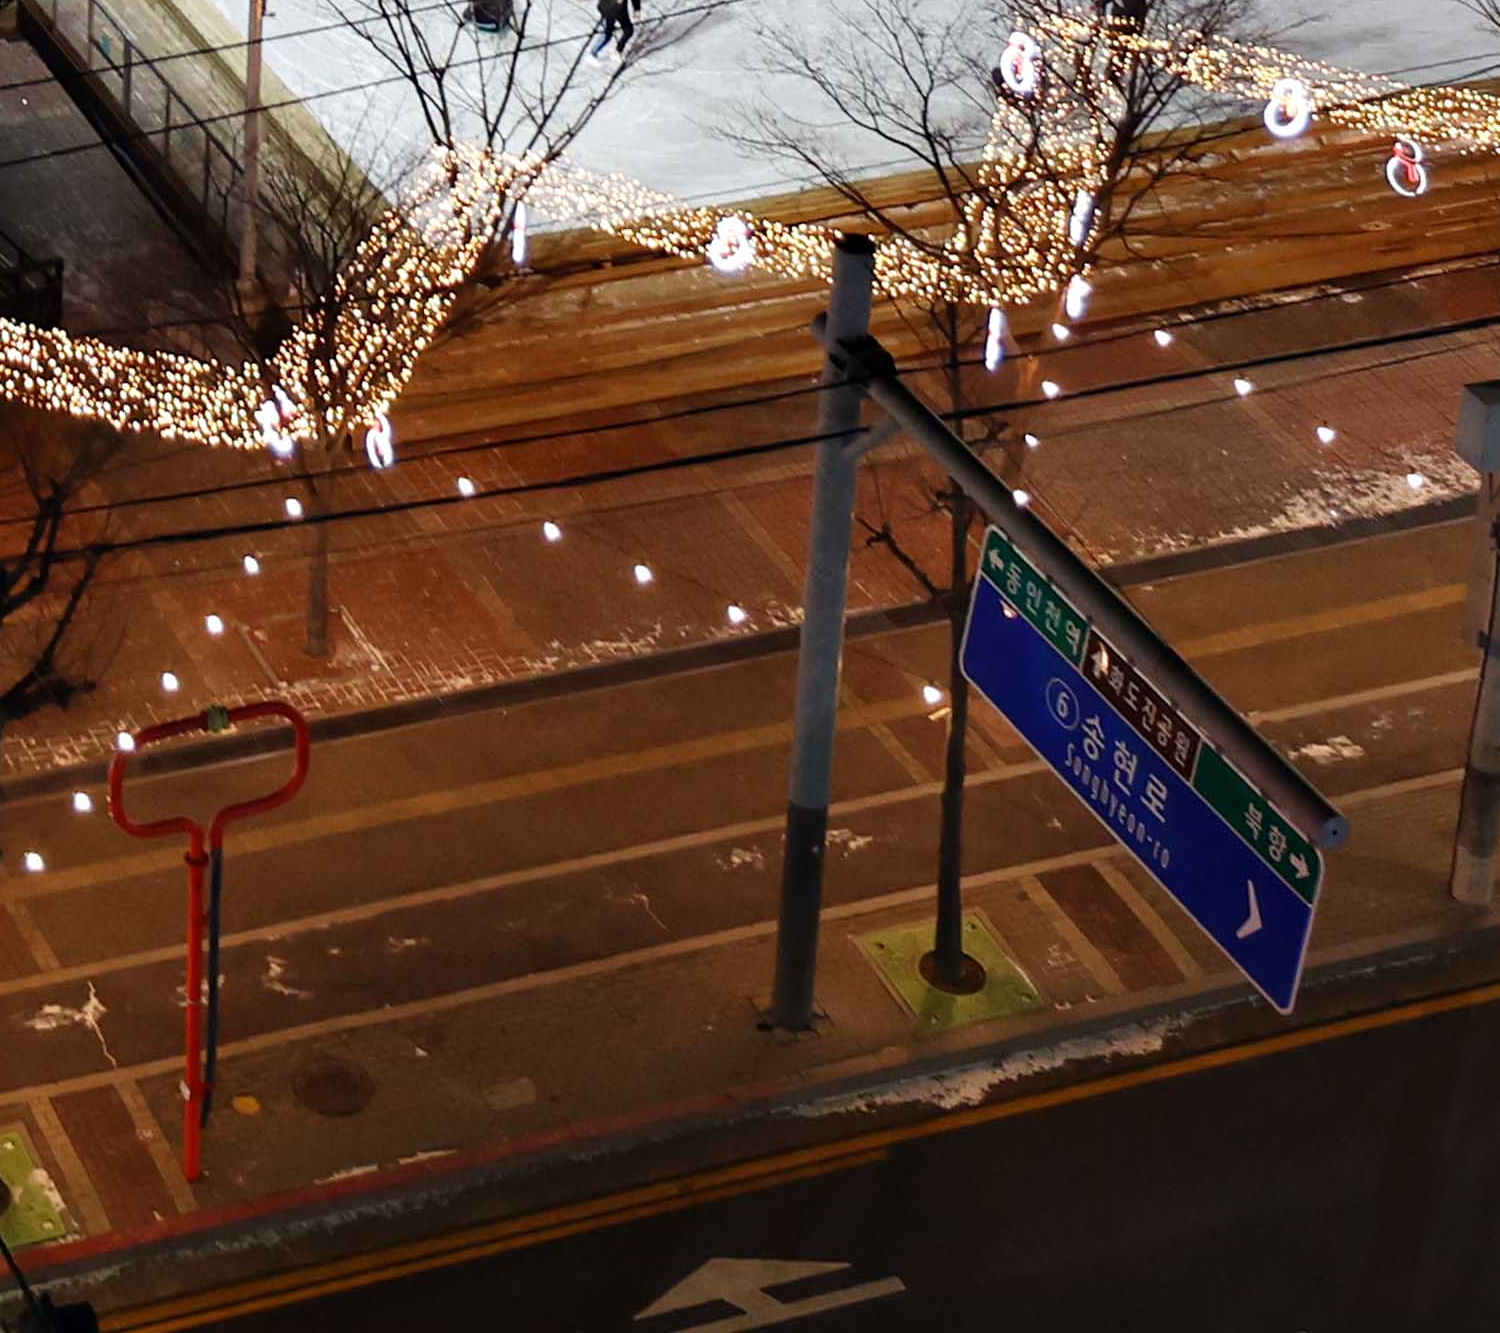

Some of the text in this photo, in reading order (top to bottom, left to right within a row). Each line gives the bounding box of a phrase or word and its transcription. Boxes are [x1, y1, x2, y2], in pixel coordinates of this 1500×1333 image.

[1004, 559, 1082, 658] 동인천역
[1105, 660, 1193, 763] 화도진공원
[1064, 740, 1173, 870] Songhyeon-ro
[1080, 712, 1171, 824] 송현로
[1243, 801, 1289, 864] 북항
